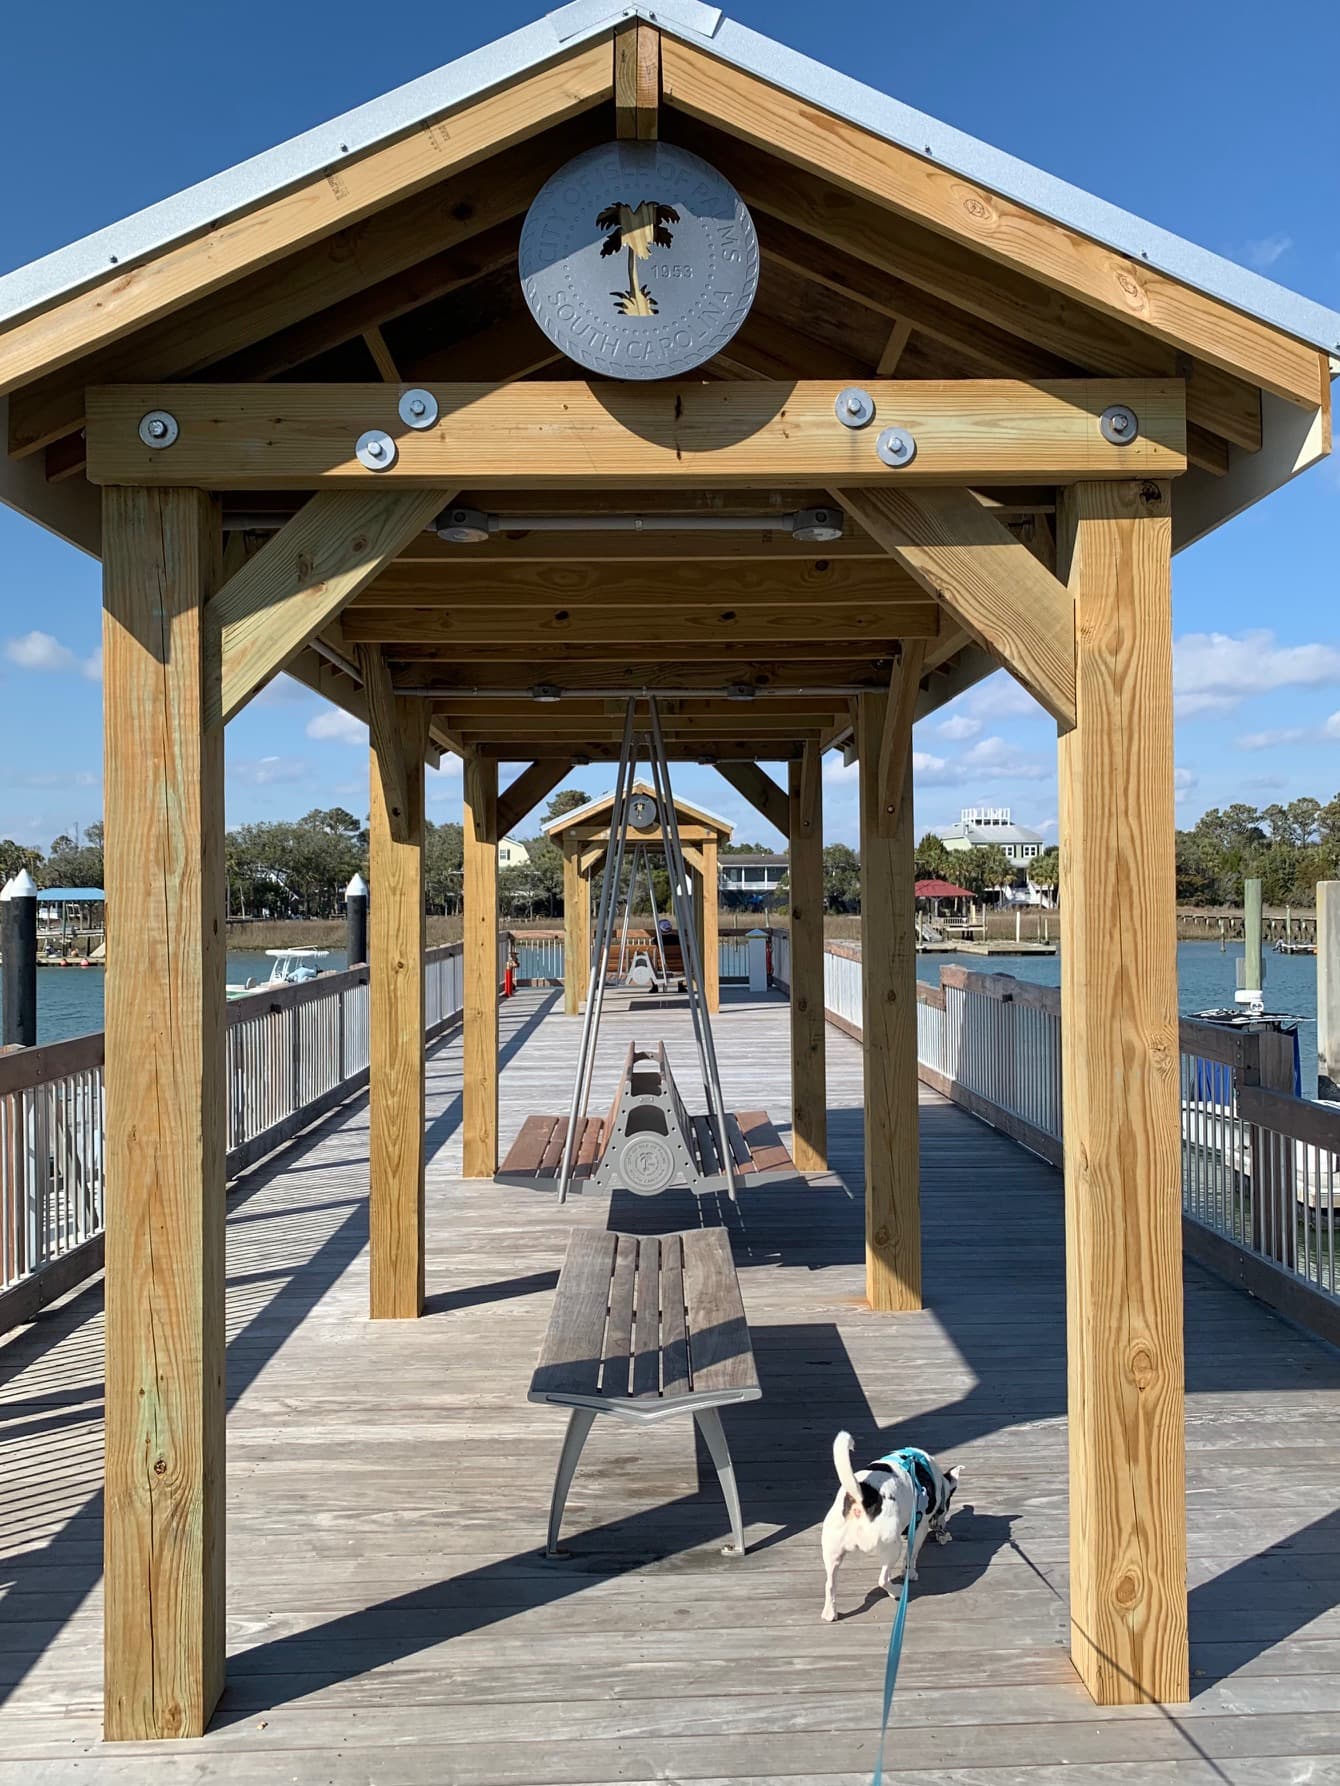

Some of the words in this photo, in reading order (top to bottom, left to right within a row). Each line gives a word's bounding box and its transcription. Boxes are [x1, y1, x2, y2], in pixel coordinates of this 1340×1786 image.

[563, 174, 591, 204] OF
[657, 163, 689, 187] OF
[692, 182, 742, 264] PALMS
[651, 265, 693, 279] 1953
[548, 291, 620, 356] SOUTH
[627, 290, 734, 361] CAROLINA
